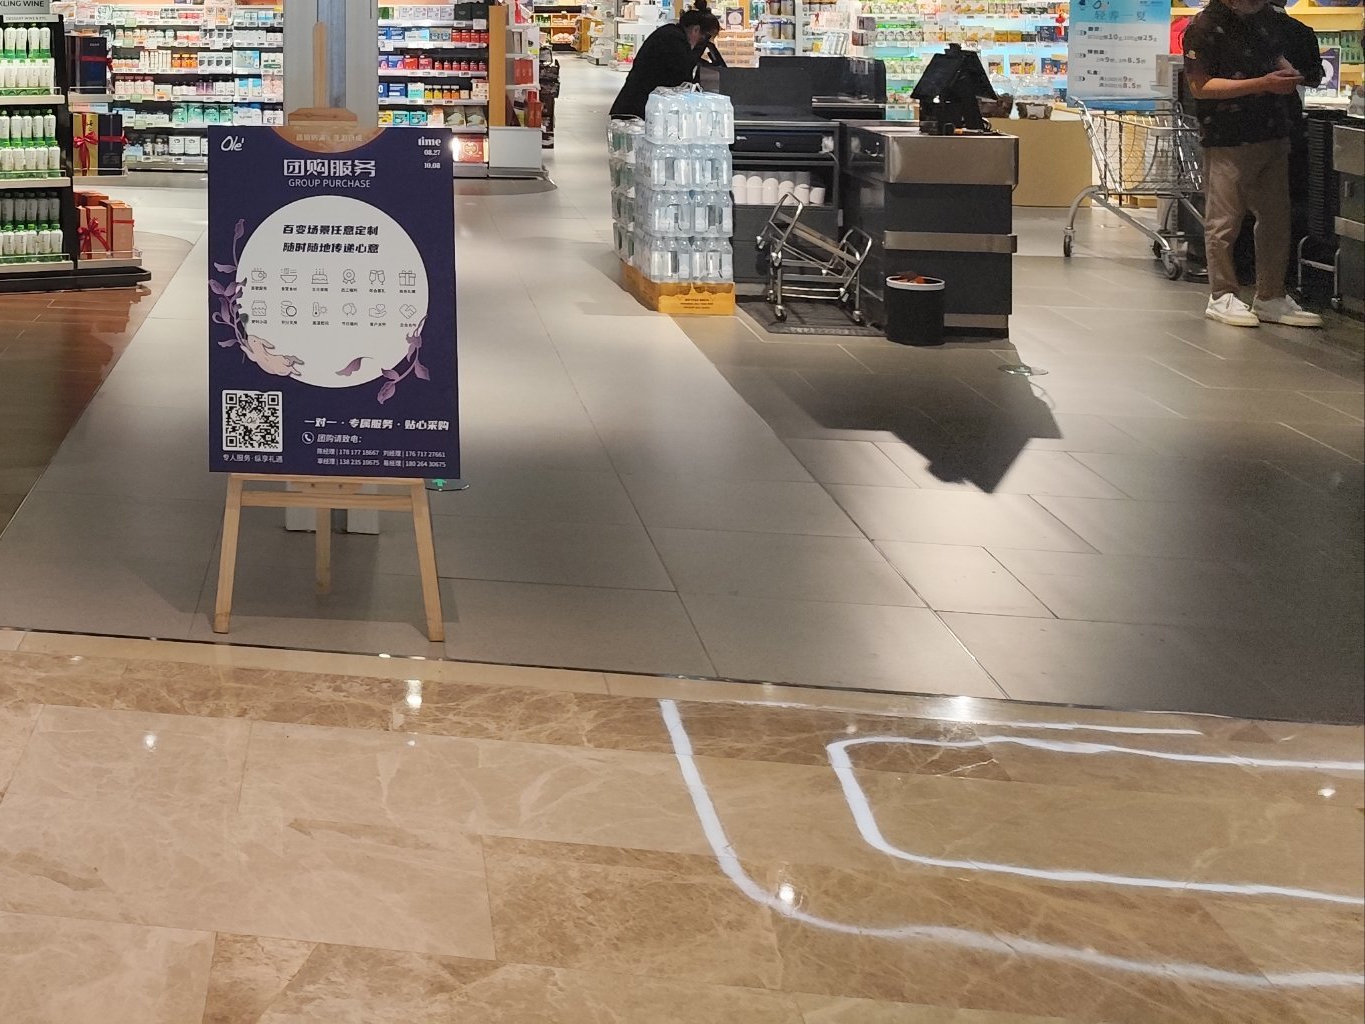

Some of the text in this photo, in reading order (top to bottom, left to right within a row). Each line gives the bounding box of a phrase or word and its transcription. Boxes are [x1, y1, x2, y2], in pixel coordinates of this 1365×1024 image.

[23, 0, 44, 8] WINE
[417, 136, 442, 146] time
[284, 159, 376, 177] 团购服务
[288, 179, 371, 188] GROUP PURCHASE
[283, 224, 378, 236] 百变场景任意定制
[282, 242, 380, 254] 随时随地传递心意
